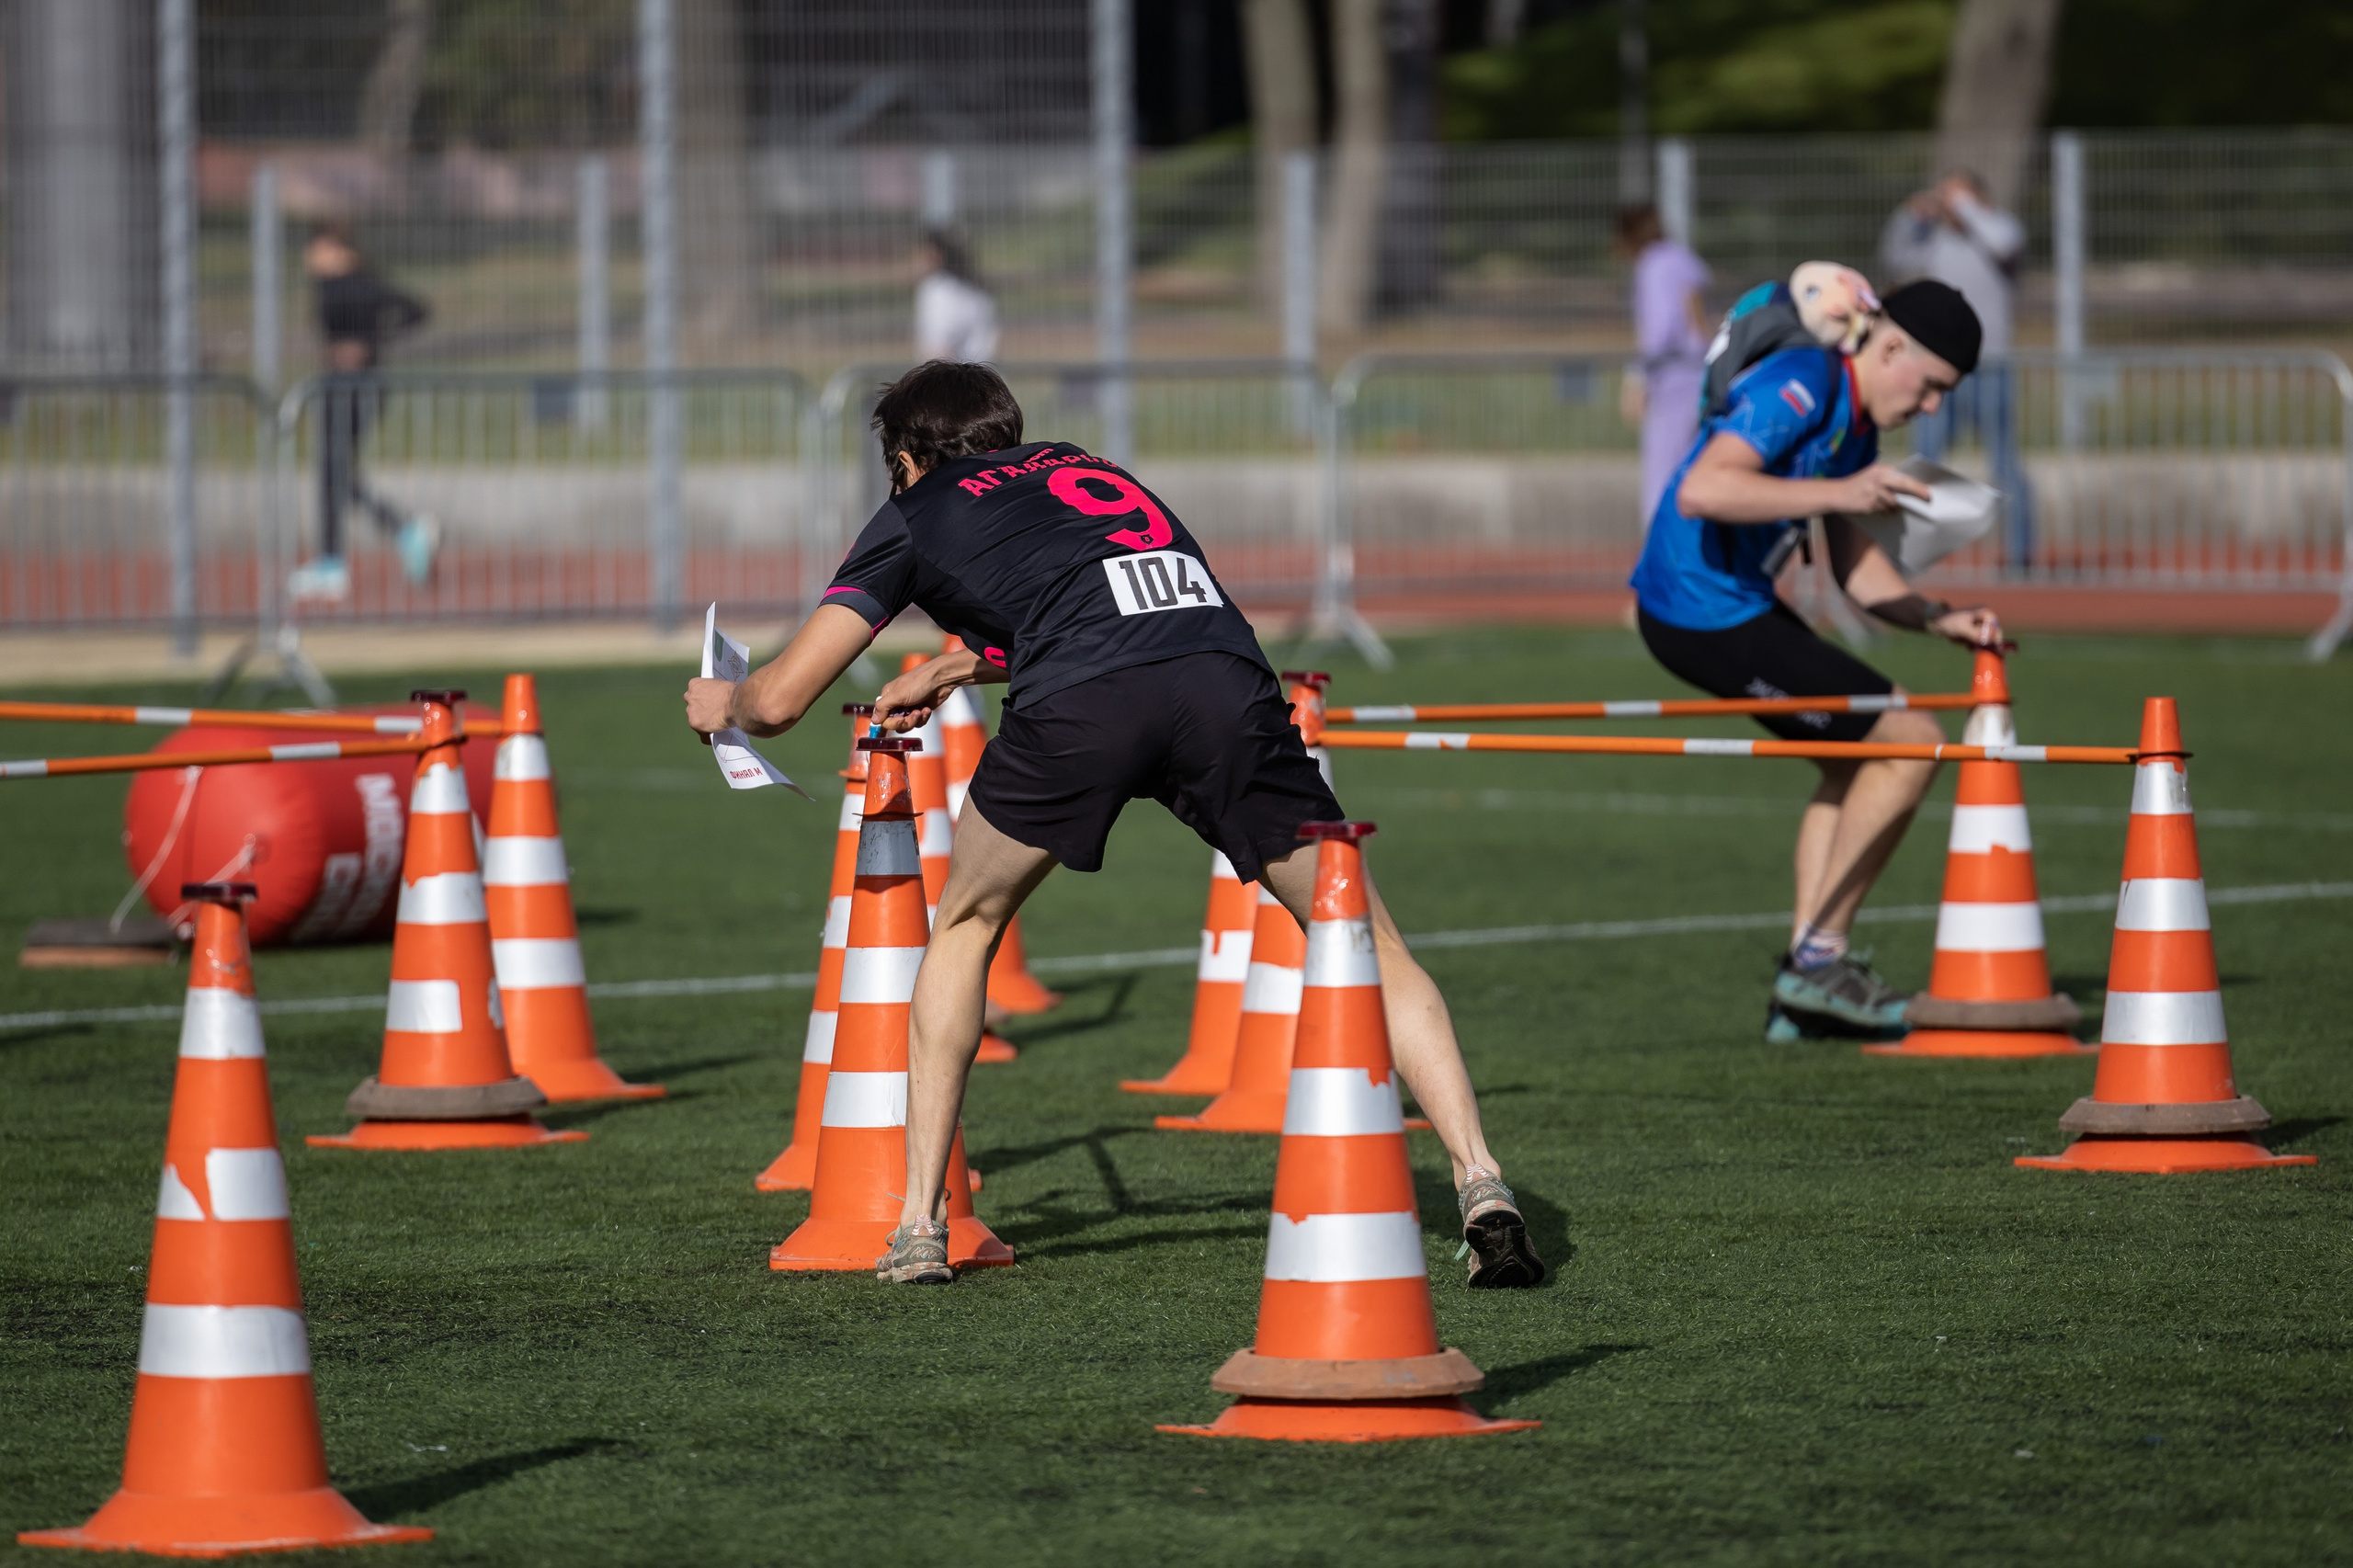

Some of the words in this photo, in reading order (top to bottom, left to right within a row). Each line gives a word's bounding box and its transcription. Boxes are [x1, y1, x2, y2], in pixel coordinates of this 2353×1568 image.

[1047, 467, 1174, 551] 9
[1118, 557, 1208, 610] 104
[730, 768, 755, 779] ФИНАЛ
[754, 767, 763, 776] М
